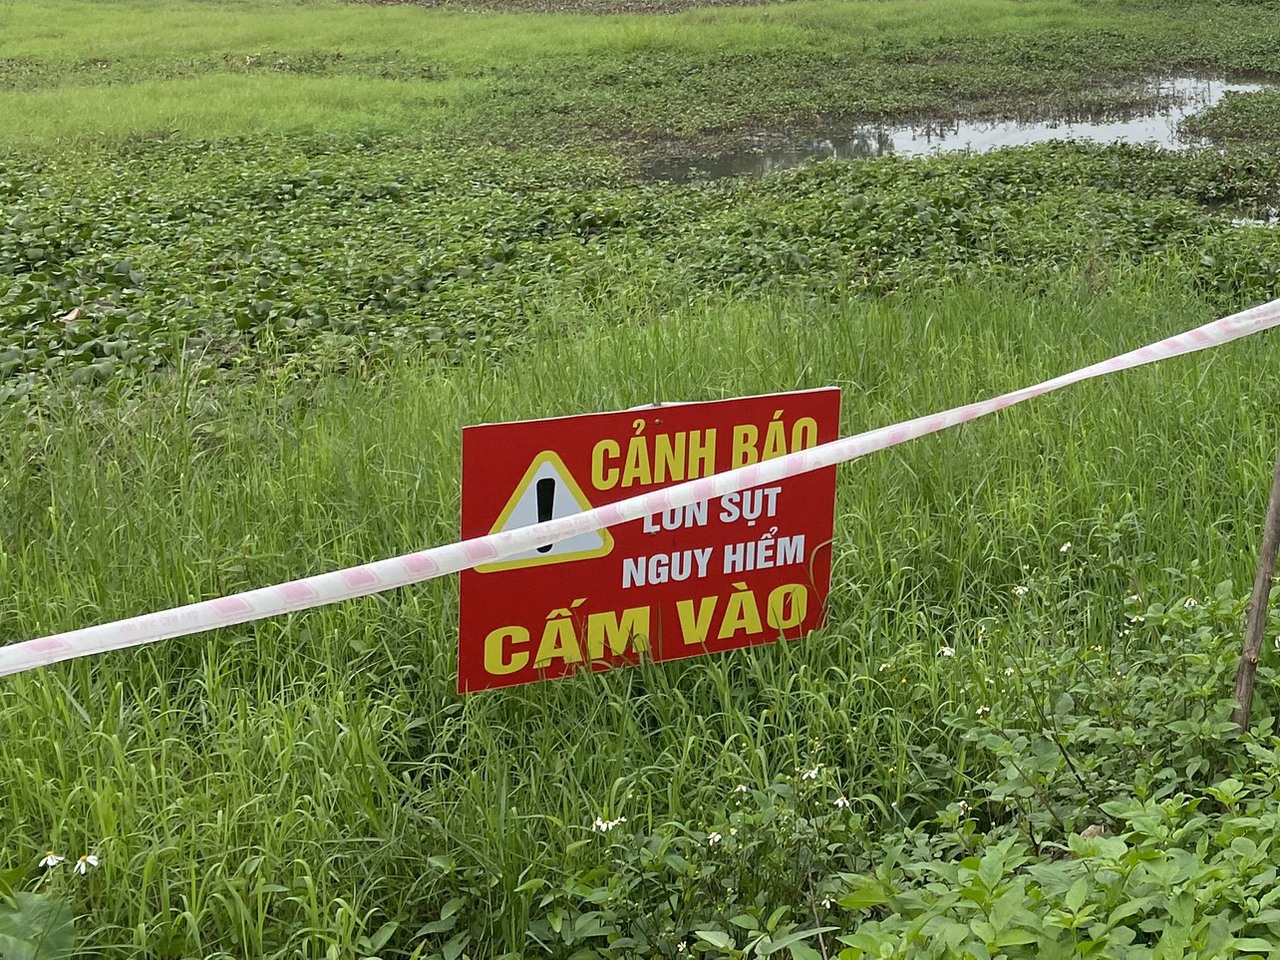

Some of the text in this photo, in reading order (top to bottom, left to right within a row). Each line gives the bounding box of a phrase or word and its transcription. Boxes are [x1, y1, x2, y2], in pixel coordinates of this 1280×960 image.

[591, 418, 717, 491] CẢNH
[719, 487, 782, 526] SỤT
[622, 526, 805, 589] NGUY HIỂM
[483, 580, 808, 676] CẤM VÀO
